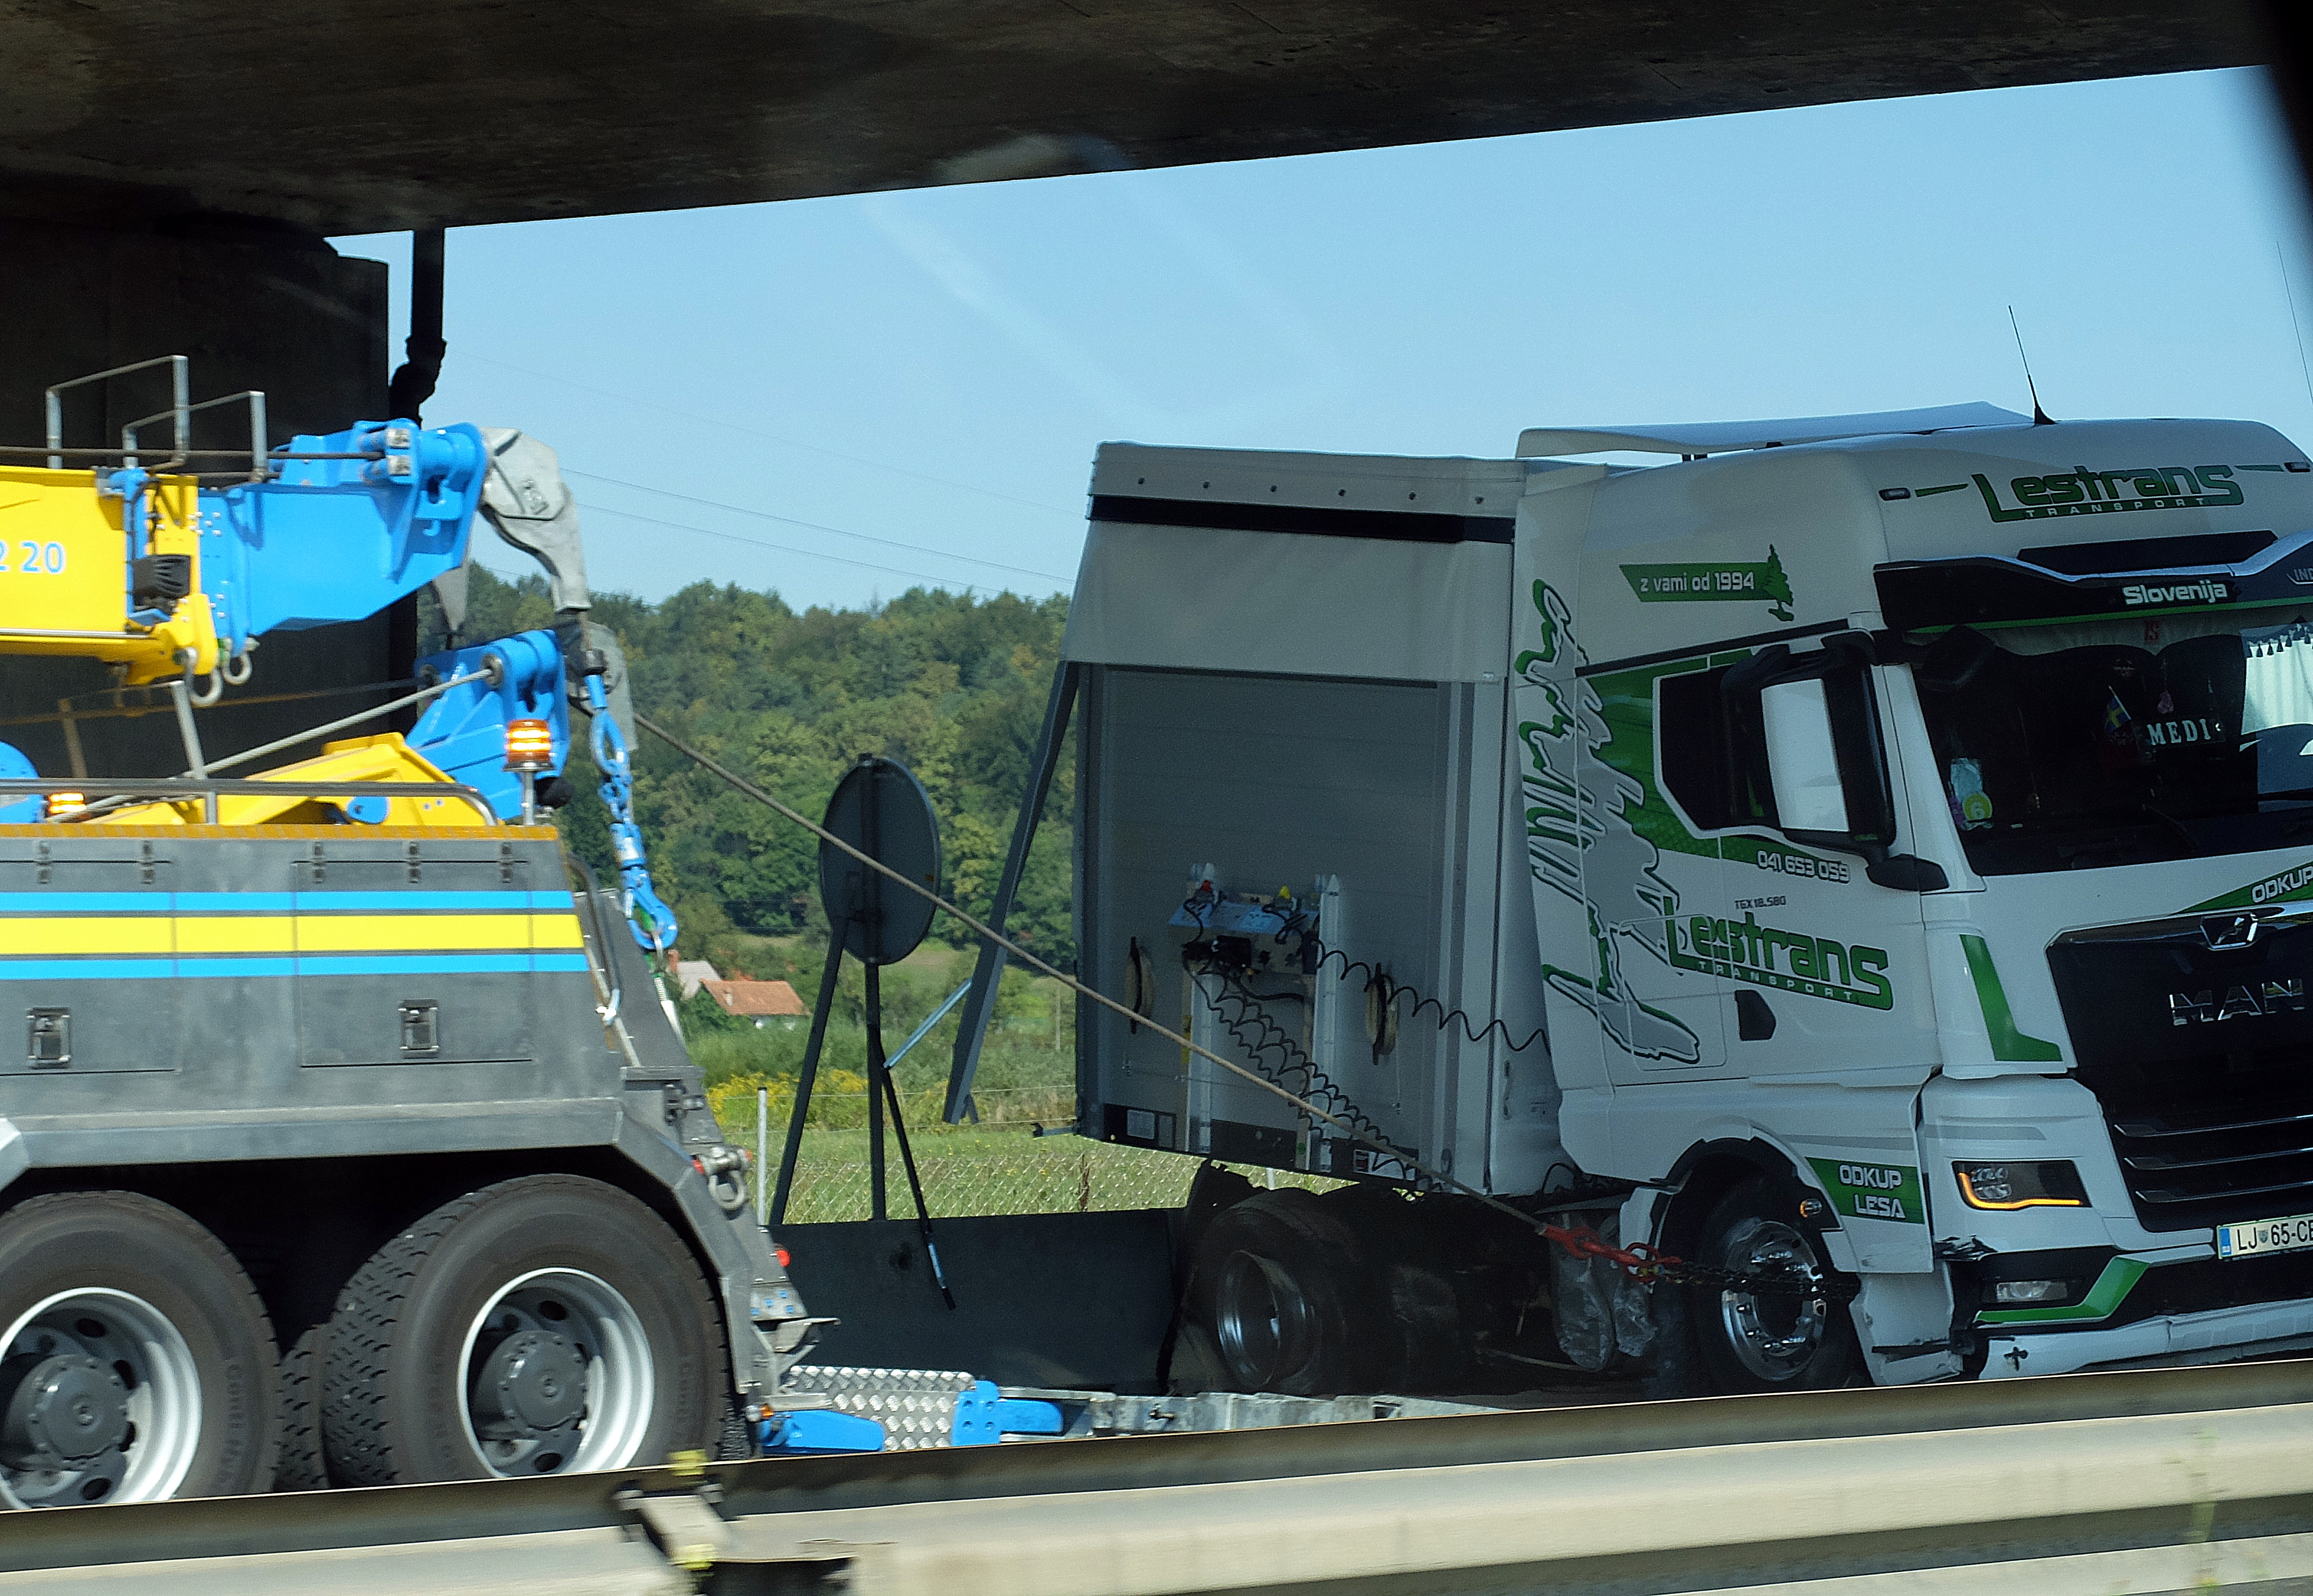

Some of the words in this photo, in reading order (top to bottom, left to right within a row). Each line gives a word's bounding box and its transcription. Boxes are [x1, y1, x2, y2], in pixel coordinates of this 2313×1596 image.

[1971, 465, 2244, 522] Lestrans
[2027, 497, 2205, 518] TRANSPORT
[22, 540, 66, 574] 20
[1640, 578, 1649, 592] z
[1653, 572, 1687, 592] vami
[1692, 571, 1710, 591] od
[1714, 572, 1754, 591] 1994
[2122, 579, 2228, 604] Slovenija
[2146, 718, 2211, 746] MEDI
[1757, 850, 1782, 872] 041
[1785, 854, 1815, 878] 653
[1818, 860, 1850, 884] 059
[2251, 866, 2313, 903] ODKUP
[1754, 895, 1786, 908] 18.580
[1663, 895, 1893, 1011] Lestrans
[1697, 961, 1854, 1001] TRANSPORT
[2169, 979, 2306, 1026] MAN
[1839, 1164, 1902, 1190] ODKUP
[1854, 1194, 1906, 1219] LESA
[2237, 1227, 2258, 1250] LJ
